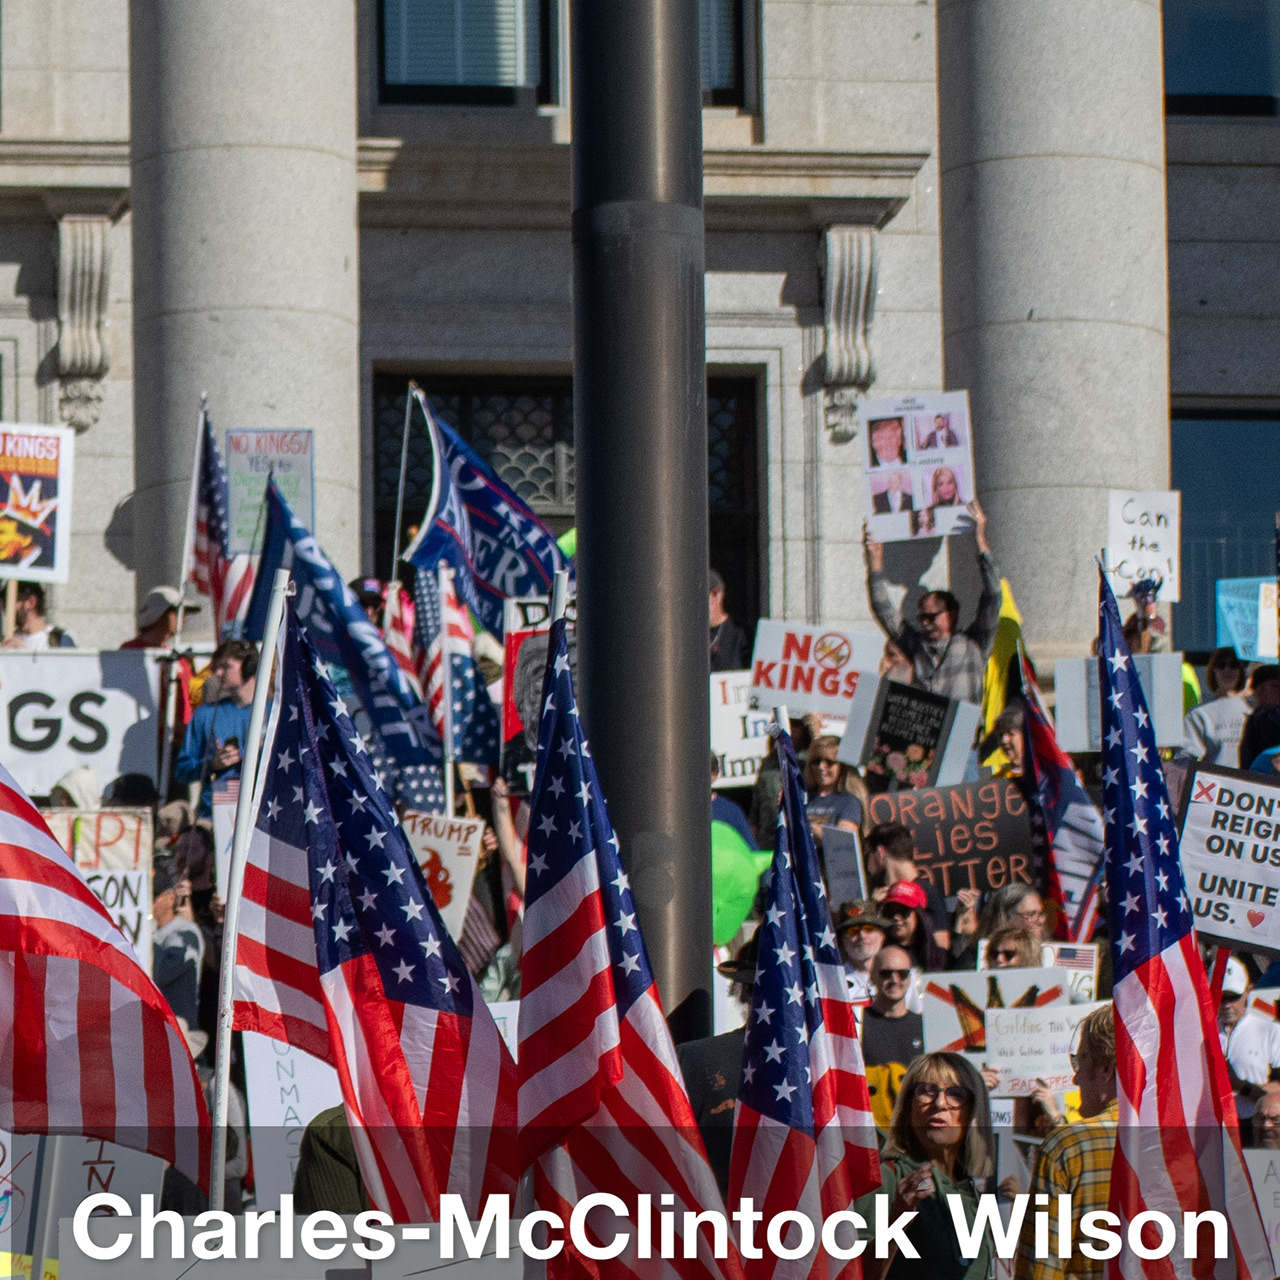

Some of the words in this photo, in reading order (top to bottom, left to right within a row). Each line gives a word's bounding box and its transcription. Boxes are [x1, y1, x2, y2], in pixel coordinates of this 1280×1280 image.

[6, 436, 58, 460] KINGS
[1121, 498, 1168, 528] Can
[1129, 535, 1159, 552] the
[753, 660, 860, 699] KINGS
[404, 814, 478, 844] TRUMP
[1205, 834, 1244, 860] ON
[1198, 872, 1279, 907] UNITE
[1193, 897, 1236, 924] US.
